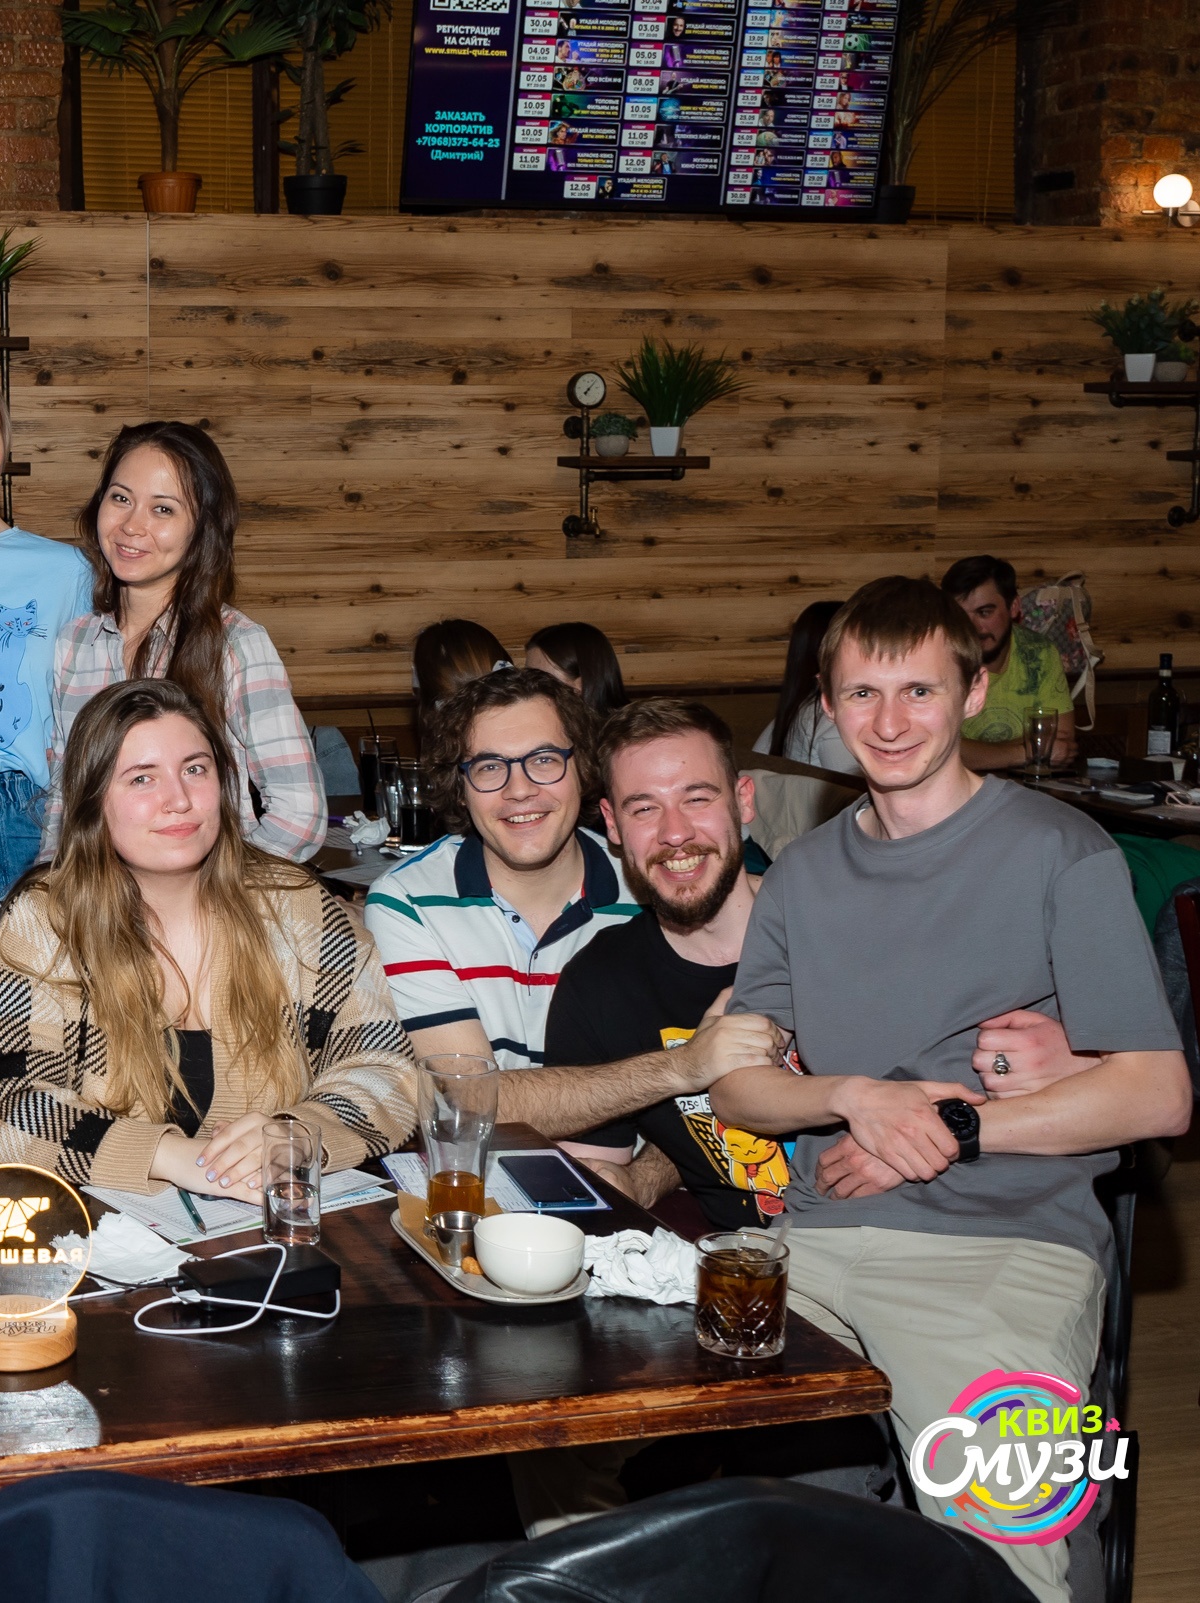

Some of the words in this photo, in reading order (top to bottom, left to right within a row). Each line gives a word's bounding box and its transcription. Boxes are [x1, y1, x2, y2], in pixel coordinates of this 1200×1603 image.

[436, 25, 500, 35] РЕГИСТРАЦИЯ
[444, 37, 457, 45] НА
[459, 36, 490, 46] САЙТЕ:
[425, 47, 507, 56] www.smuzi-quiz.com
[528, 47, 550, 55] 04.05
[435, 111, 485, 121] ЗАКАЗАТЬ
[425, 124, 493, 134] КОРПОРАТИВ
[416, 136, 500, 147] +7(968)375-64-23
[431, 150, 483, 161] (Дмитрий)
